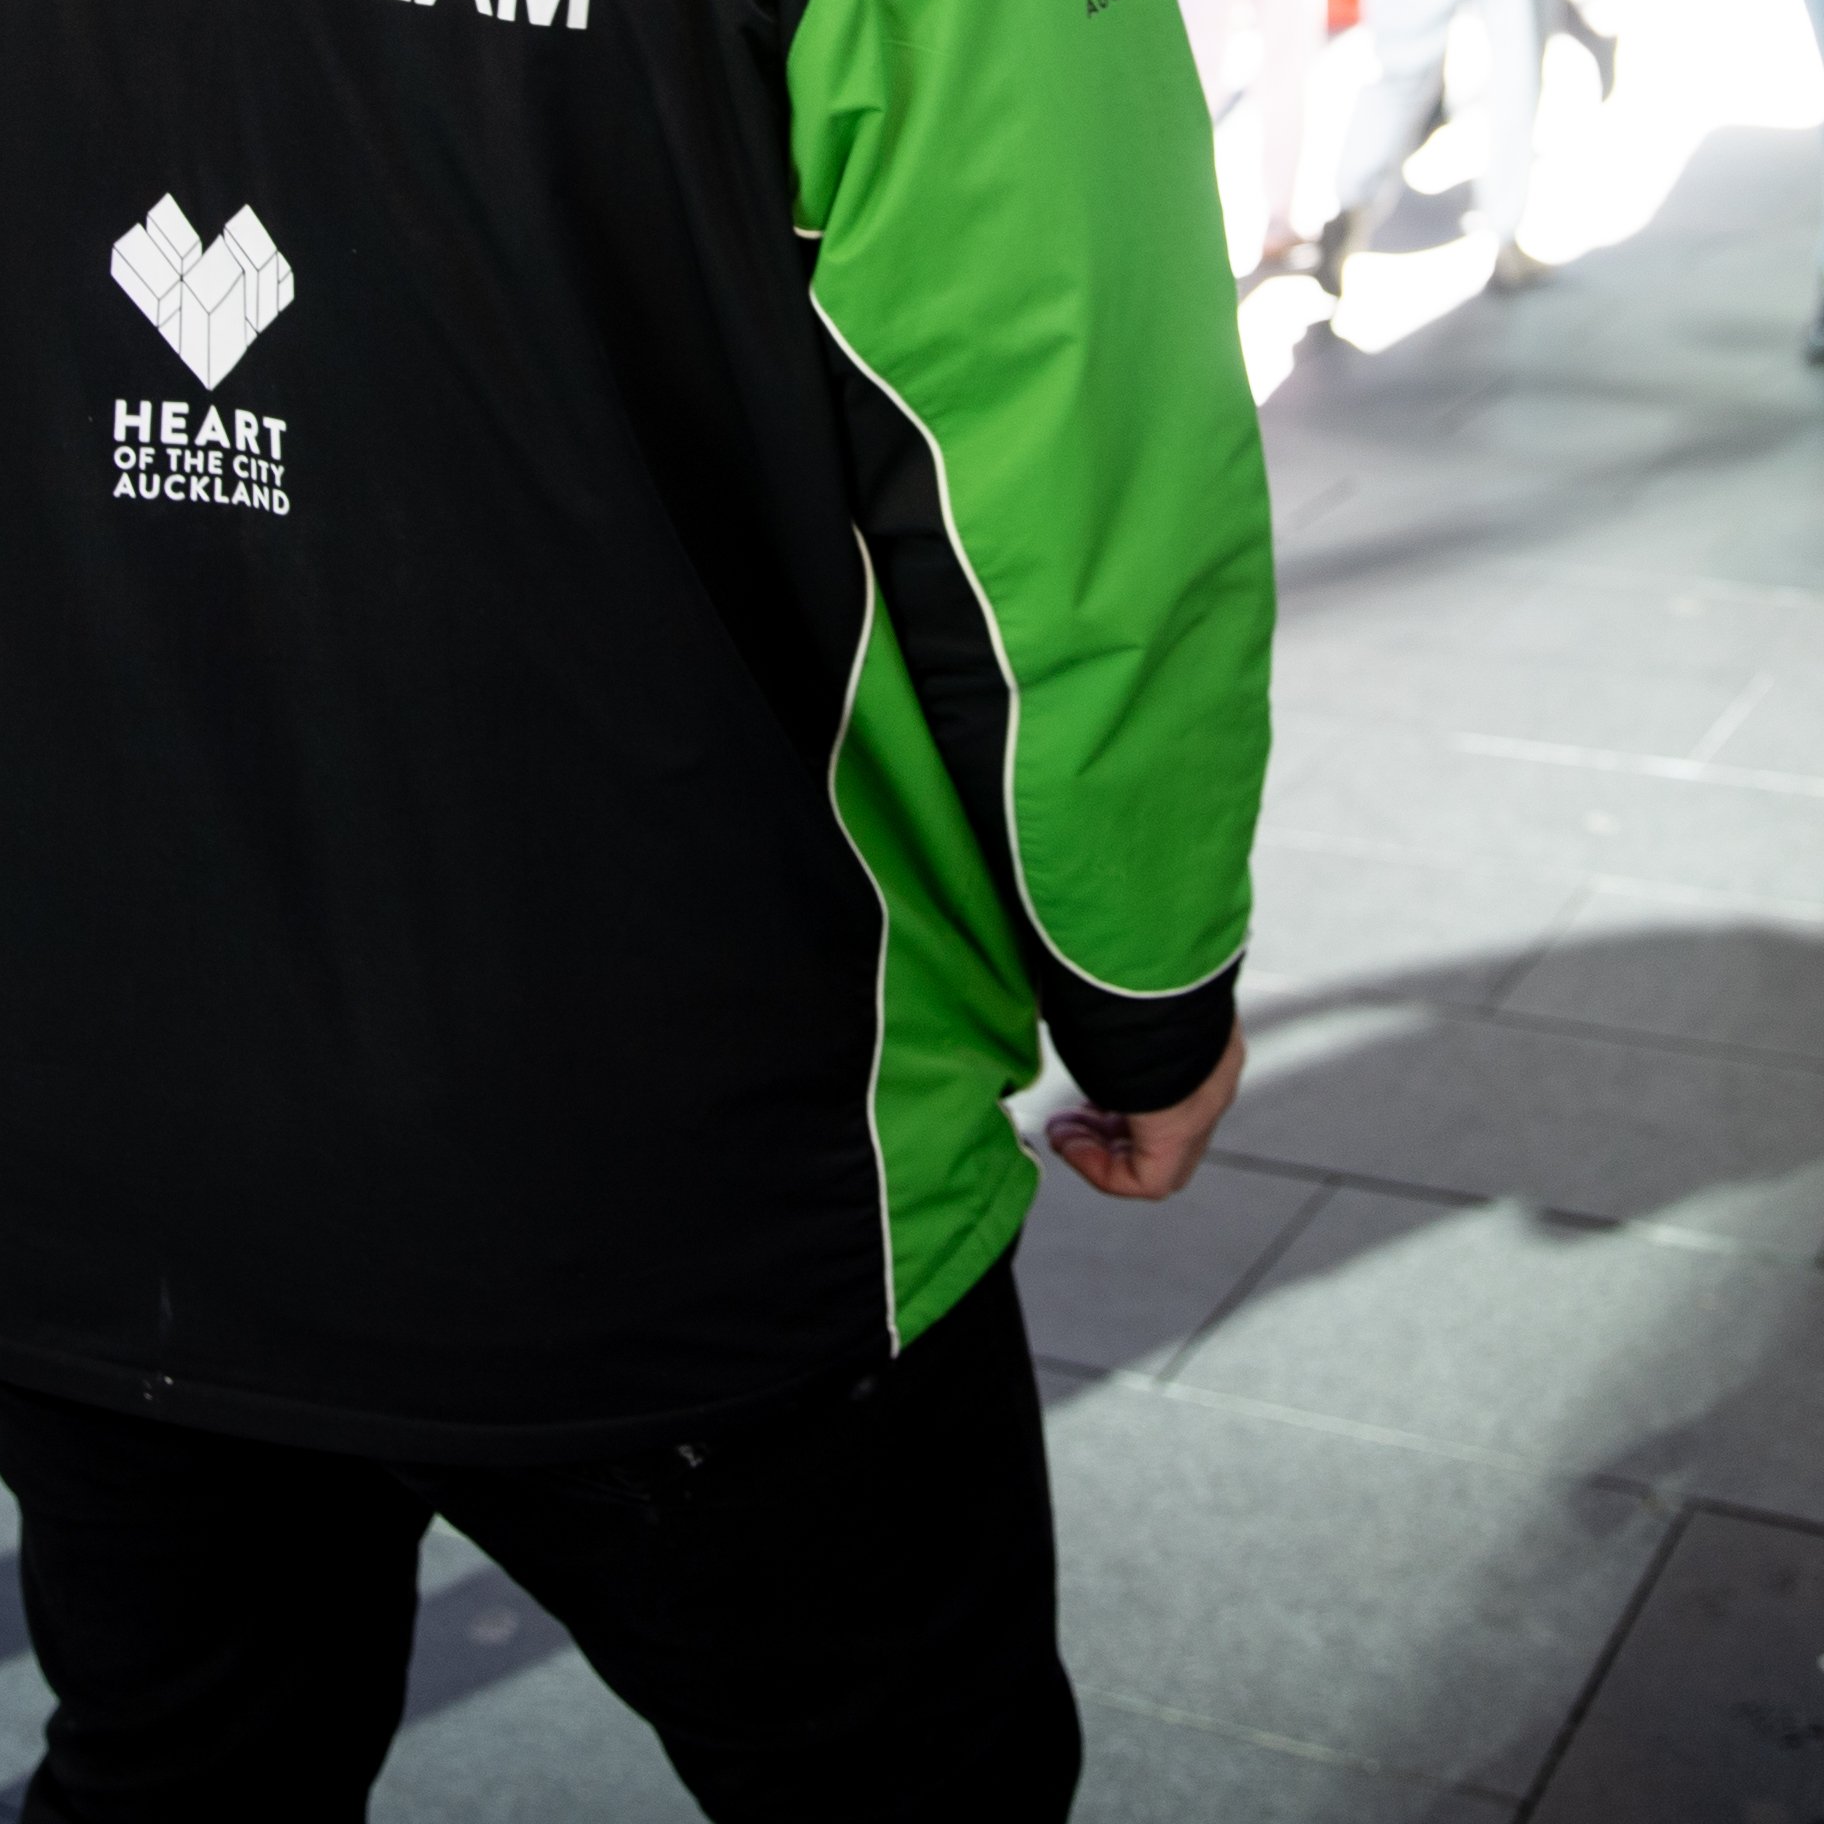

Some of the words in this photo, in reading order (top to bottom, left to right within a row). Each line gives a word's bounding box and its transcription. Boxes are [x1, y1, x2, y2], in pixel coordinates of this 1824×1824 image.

[113, 398, 287, 461] HEART
[113, 445, 156, 471] OF
[165, 447, 224, 475] THE
[232, 454, 285, 488] CITY
[113, 471, 290, 516] AUCKLAND
